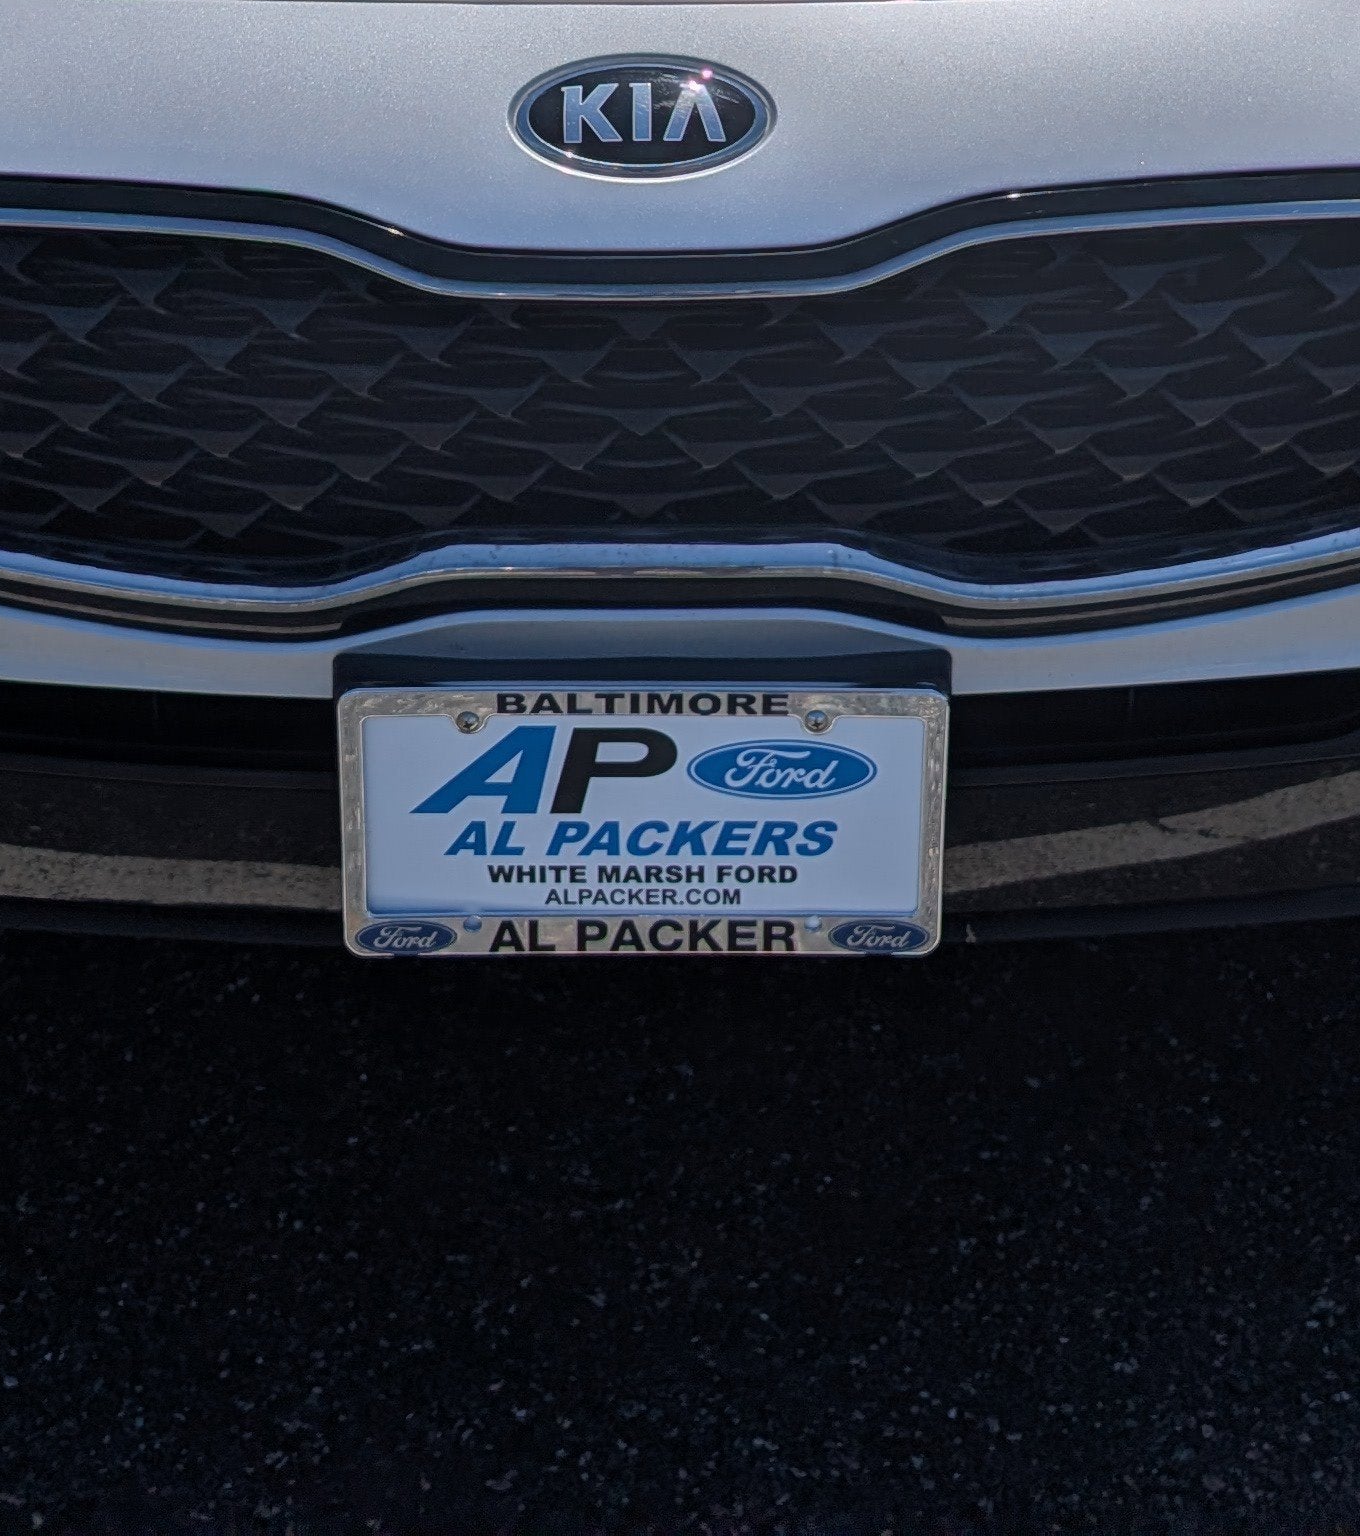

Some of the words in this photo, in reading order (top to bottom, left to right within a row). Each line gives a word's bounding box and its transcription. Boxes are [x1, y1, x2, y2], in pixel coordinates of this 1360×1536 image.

[561, 82, 727, 144] KIA
[496, 693, 789, 715] BALTIMORE
[409, 725, 678, 814] AP
[725, 748, 839, 789] Ford
[444, 821, 525, 856] AL
[546, 820, 838, 856] PACKERS
[488, 865, 586, 884] WHITE
[597, 865, 705, 884] MARSH
[716, 865, 798, 884] FORD
[545, 889, 741, 906] ALPACKER.COM
[373, 926, 438, 949] Ford
[489, 920, 556, 953] AL
[577, 920, 796, 952] PACKER
[847, 925, 912, 948] Ford
